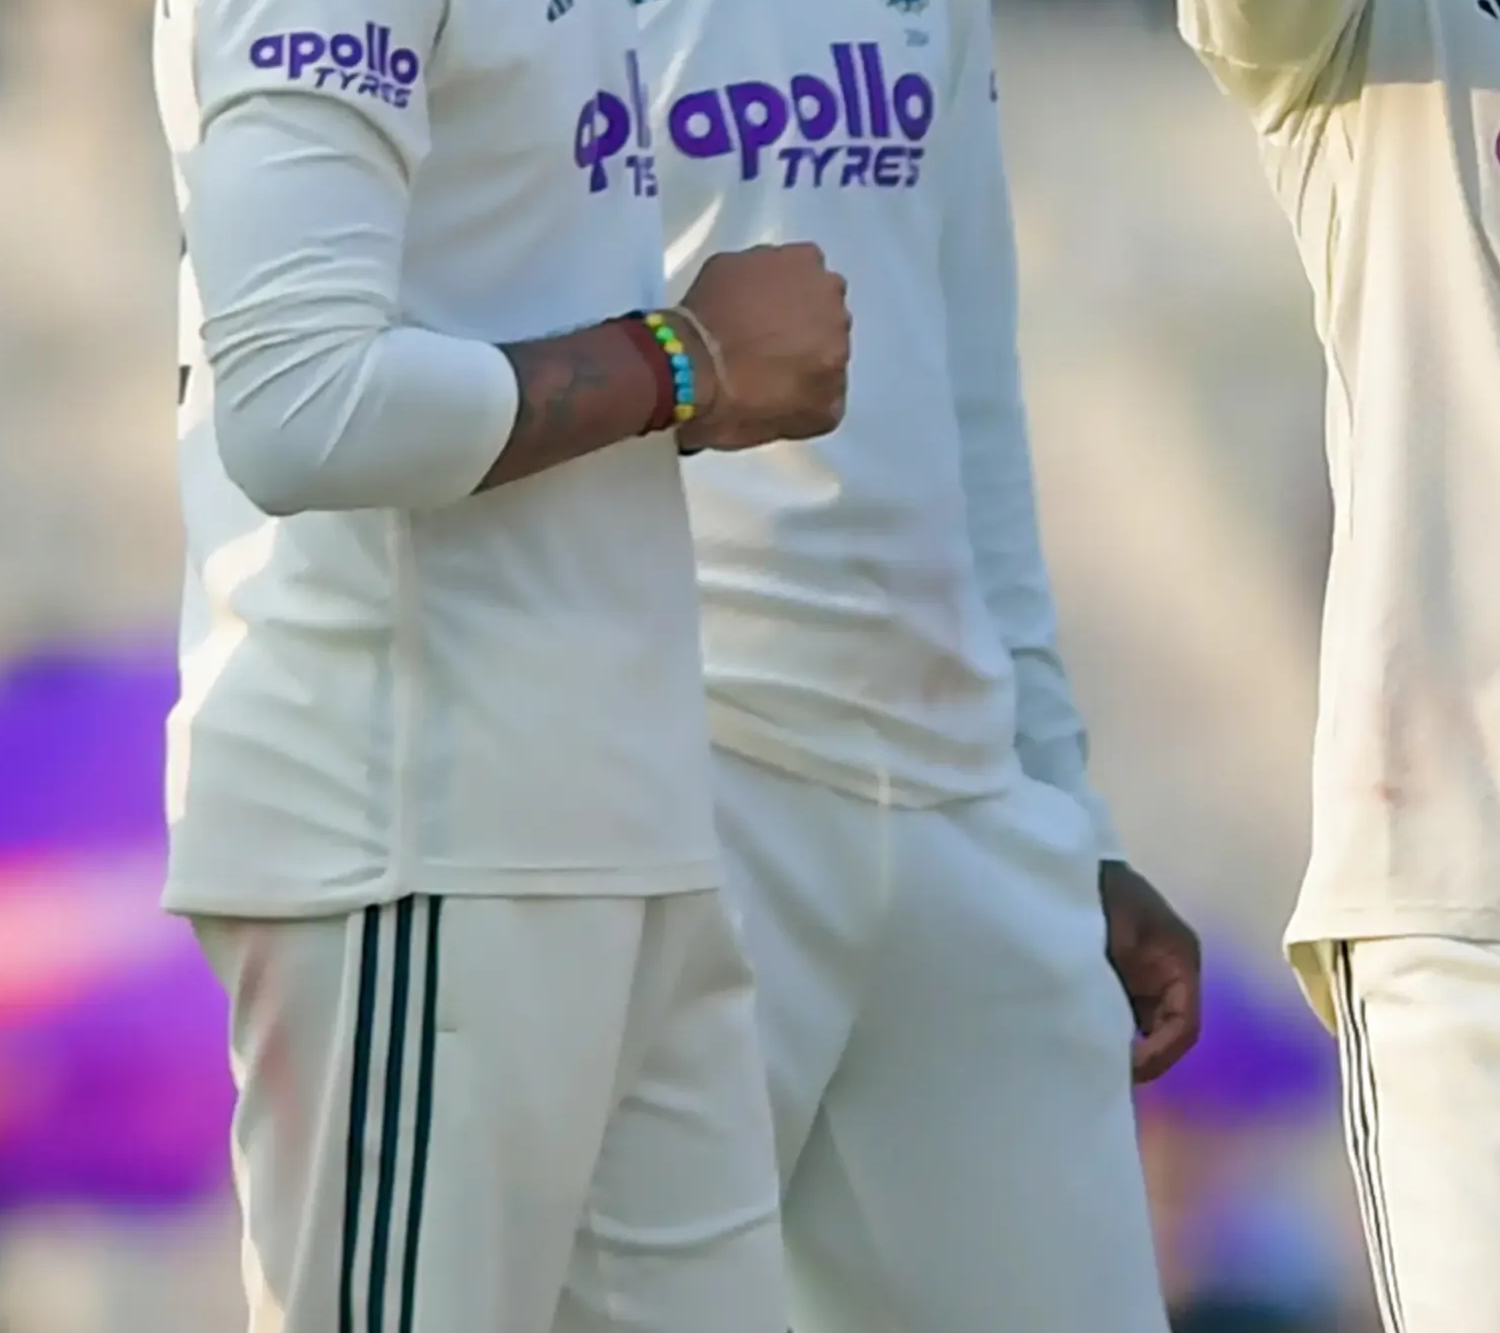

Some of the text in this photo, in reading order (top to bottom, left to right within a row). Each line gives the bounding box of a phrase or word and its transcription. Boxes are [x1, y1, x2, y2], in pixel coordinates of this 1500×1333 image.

[250, 21, 419, 84] apollo
[314, 67, 411, 109] TYRES
[669, 42, 934, 180] apollo
[778, 146, 925, 188] TYRES
